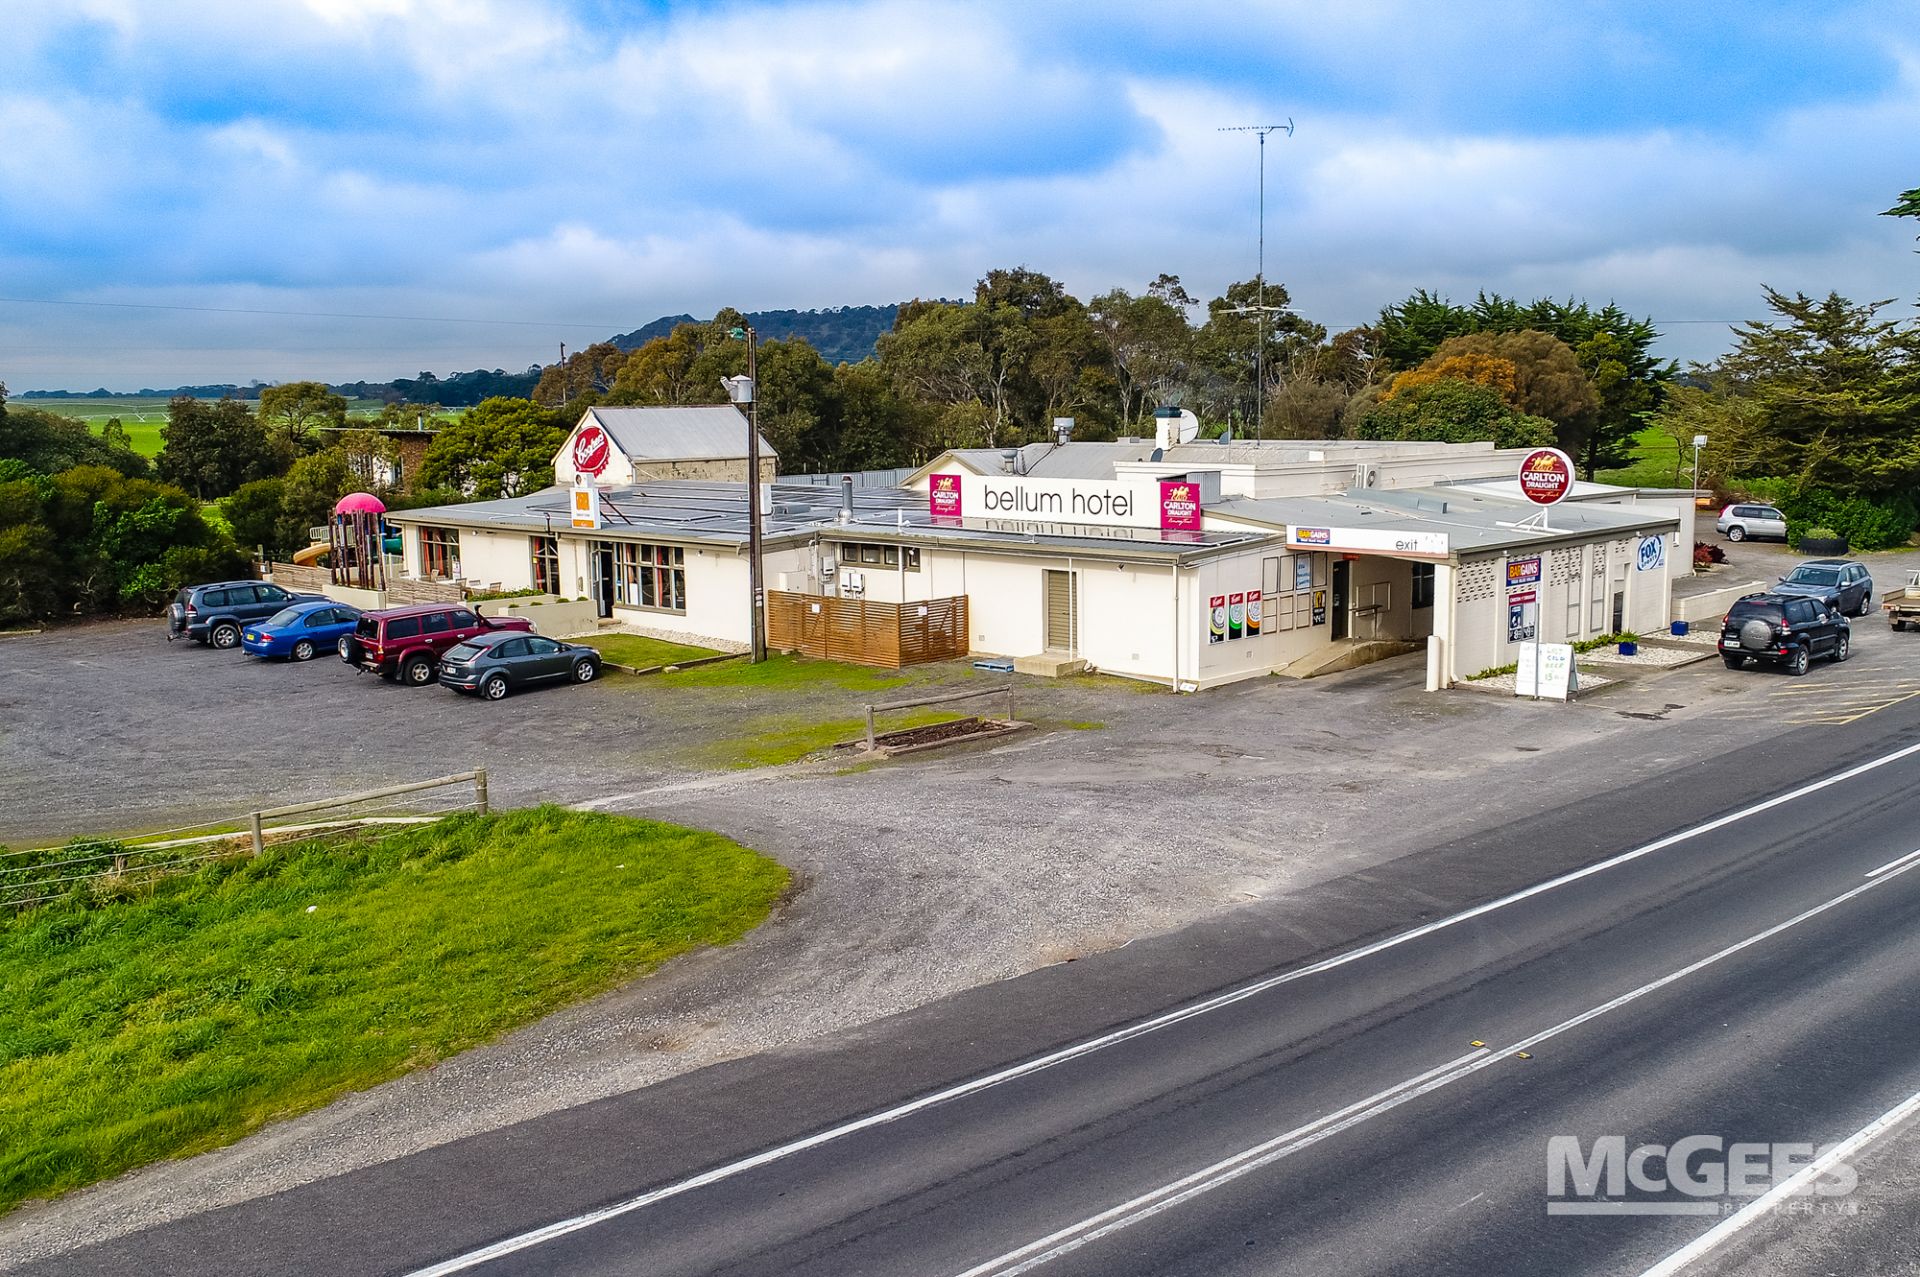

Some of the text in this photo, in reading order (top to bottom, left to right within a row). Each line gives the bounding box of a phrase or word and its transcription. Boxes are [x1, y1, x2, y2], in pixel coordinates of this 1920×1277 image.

[1521, 472, 1565, 483] CARLTON
[1526, 481, 1559, 489] DRAUGHT
[932, 491, 959, 500] CARLTON
[984, 484, 1133, 517] bellum hotel
[1163, 501, 1196, 511] CARLTON
[1395, 539, 1418, 551] exit
[1641, 539, 1657, 562] FOX
[1509, 562, 1538, 578] BARGAINS
